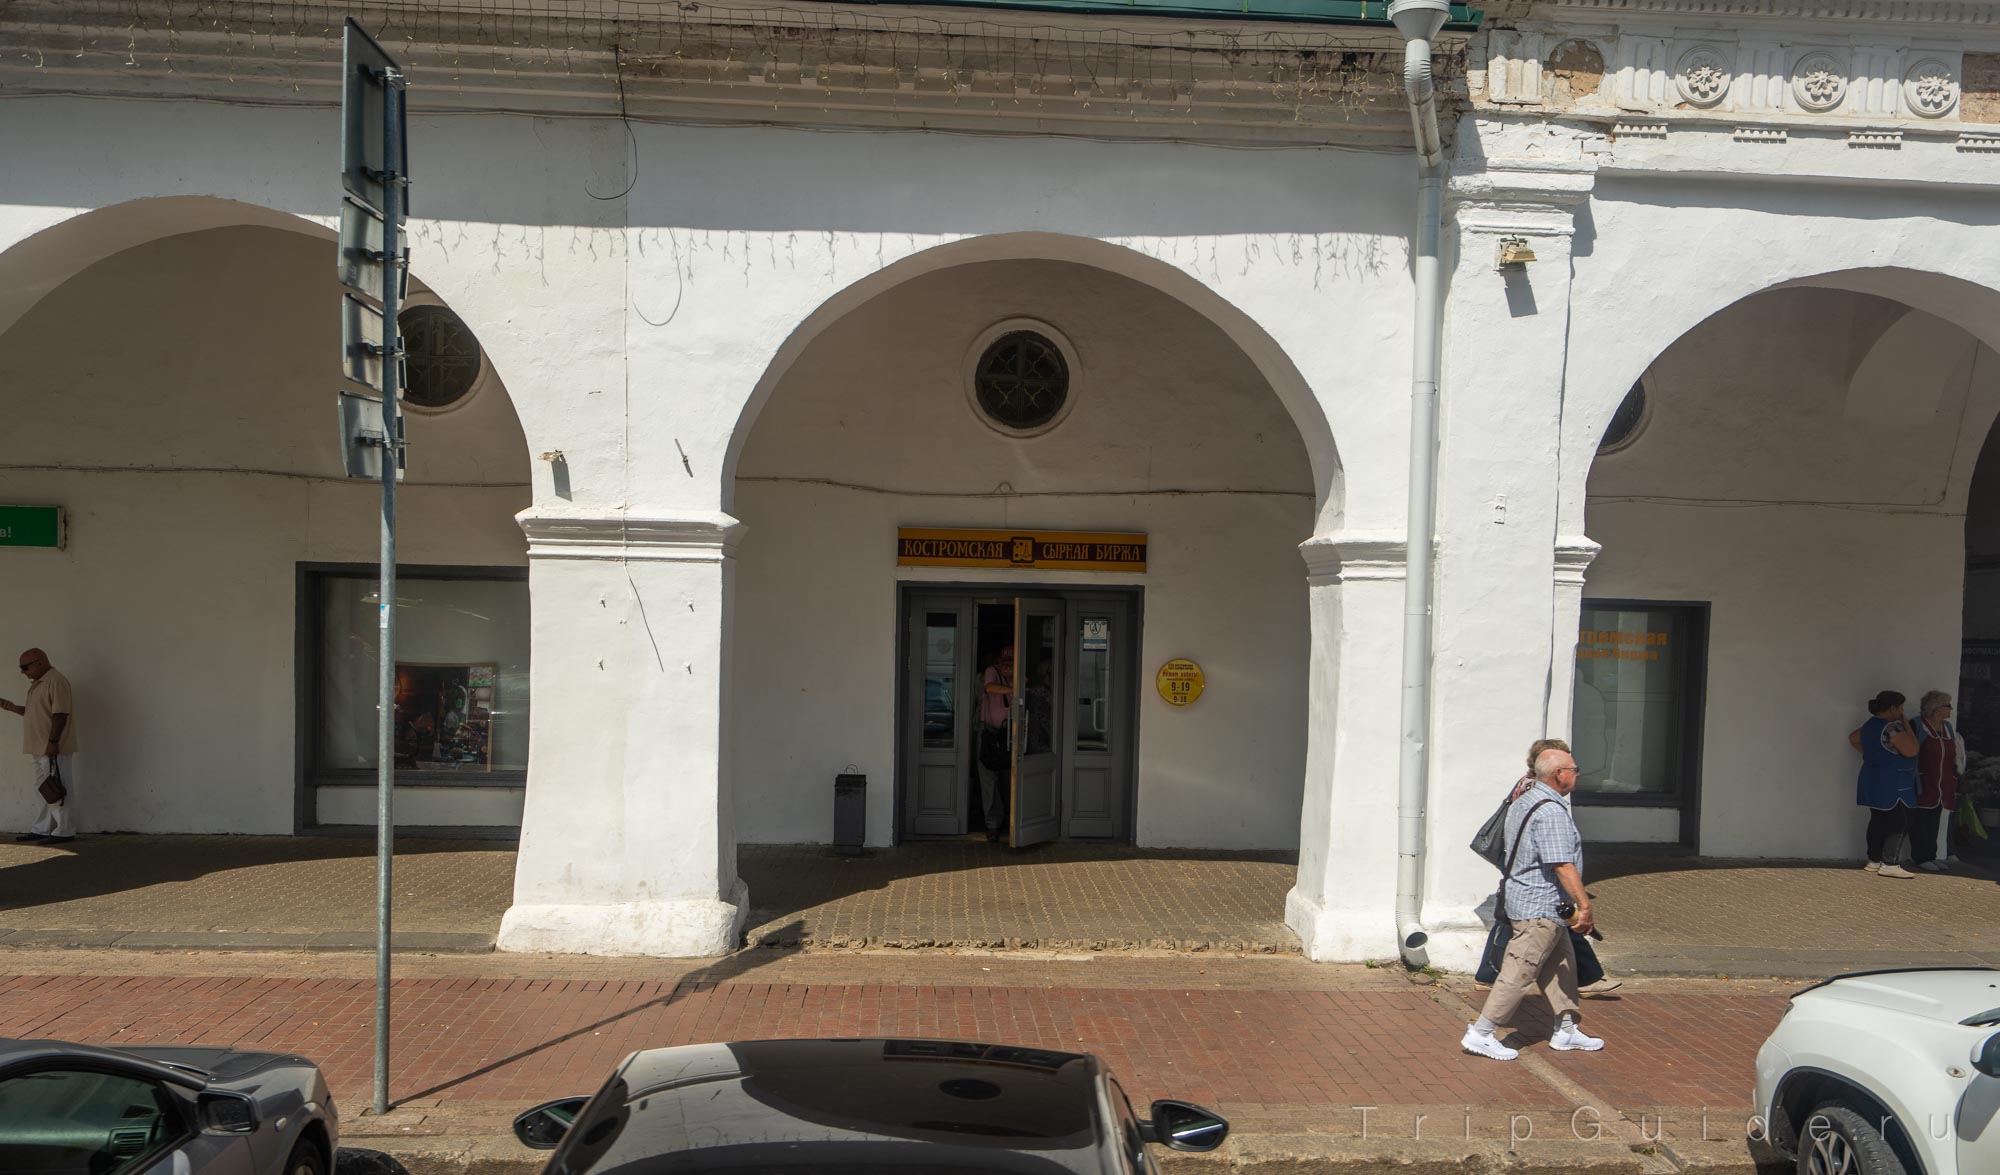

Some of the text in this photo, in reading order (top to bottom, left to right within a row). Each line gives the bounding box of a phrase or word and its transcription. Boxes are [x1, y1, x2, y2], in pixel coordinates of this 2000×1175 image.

[904, 539, 1141, 561] КОСТРОМСКАЯ СЫРНАЯ БИРЖА
